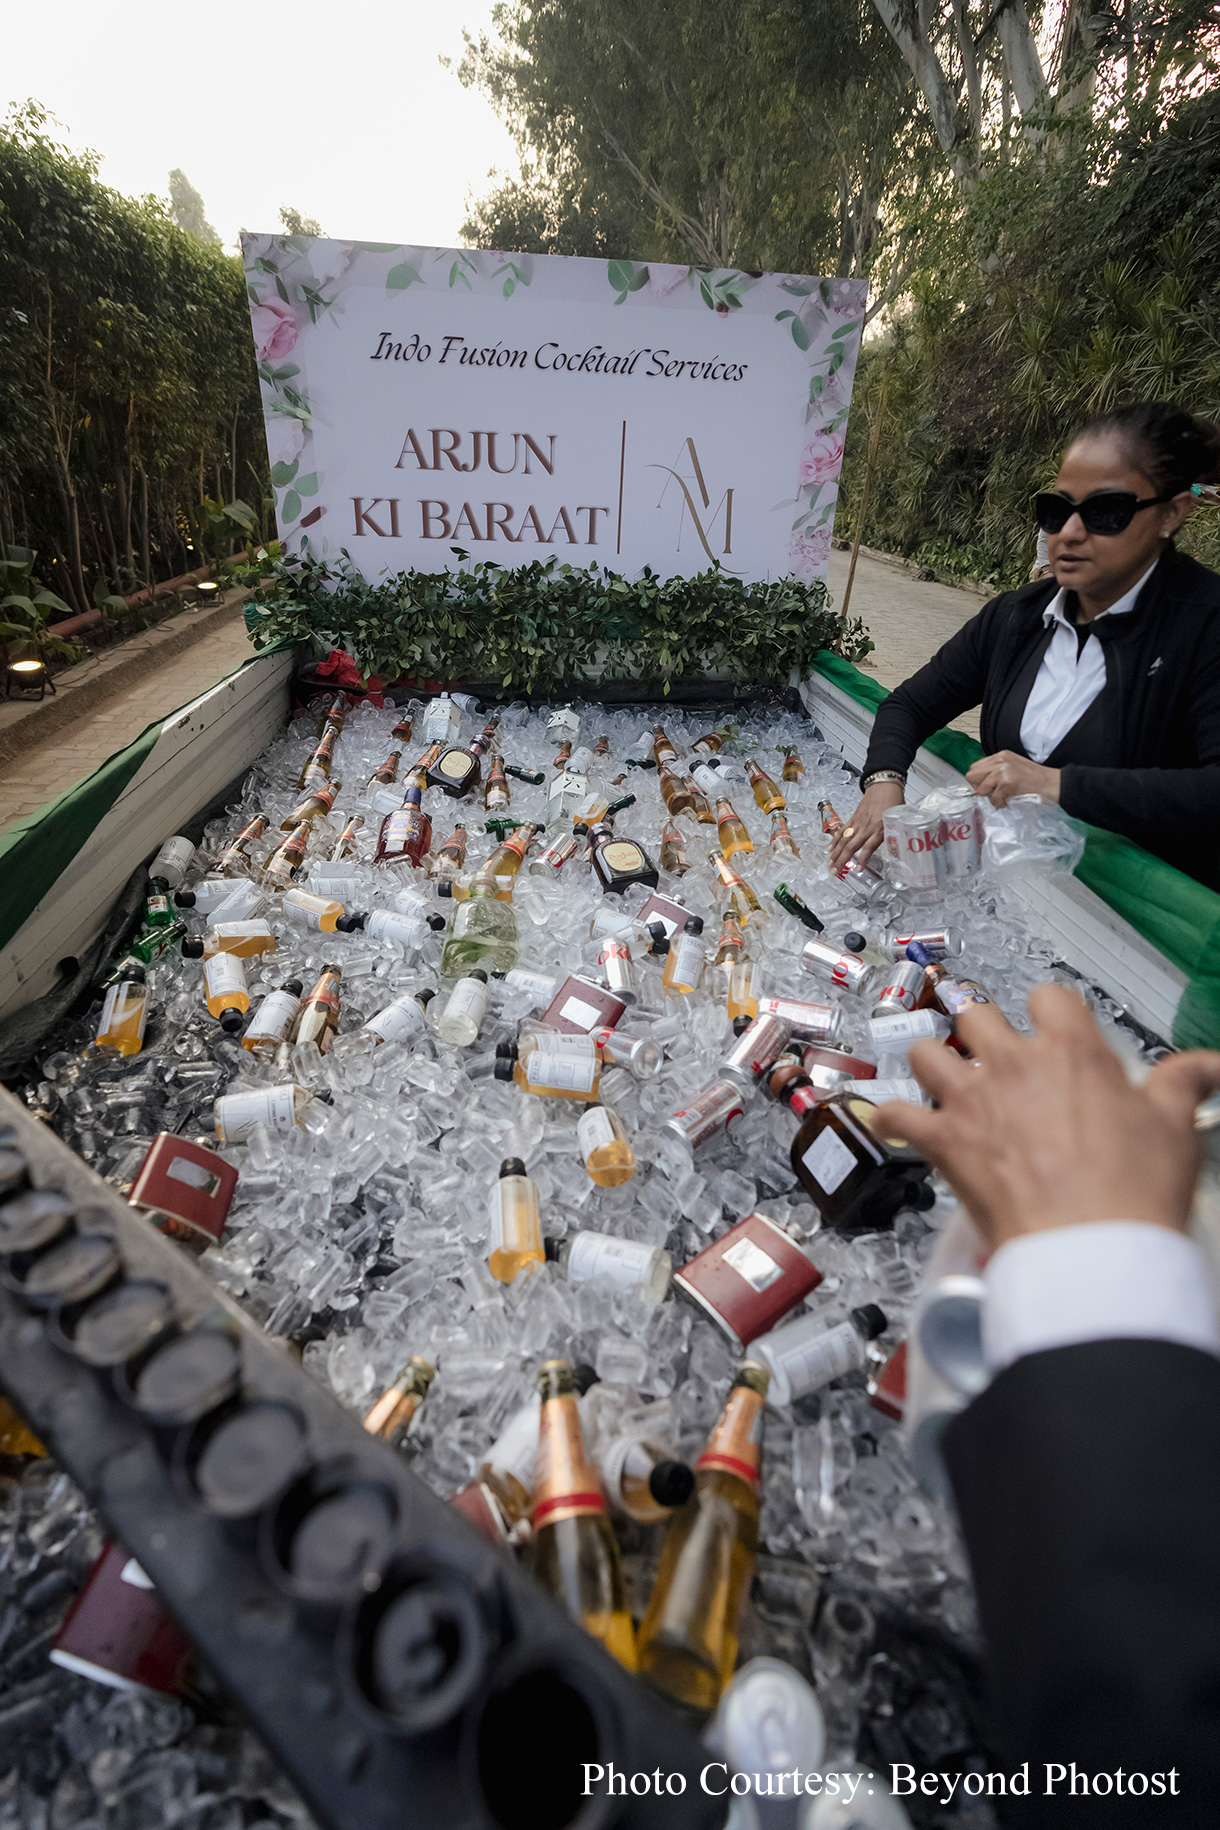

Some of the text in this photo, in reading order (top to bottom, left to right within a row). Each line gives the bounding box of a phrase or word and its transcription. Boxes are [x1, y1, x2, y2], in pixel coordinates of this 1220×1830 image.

[369, 331, 749, 382] Indo Fusion Cocktail Services
[394, 427, 558, 476] ARJUN
[349, 497, 610, 546] KI BARAAT
